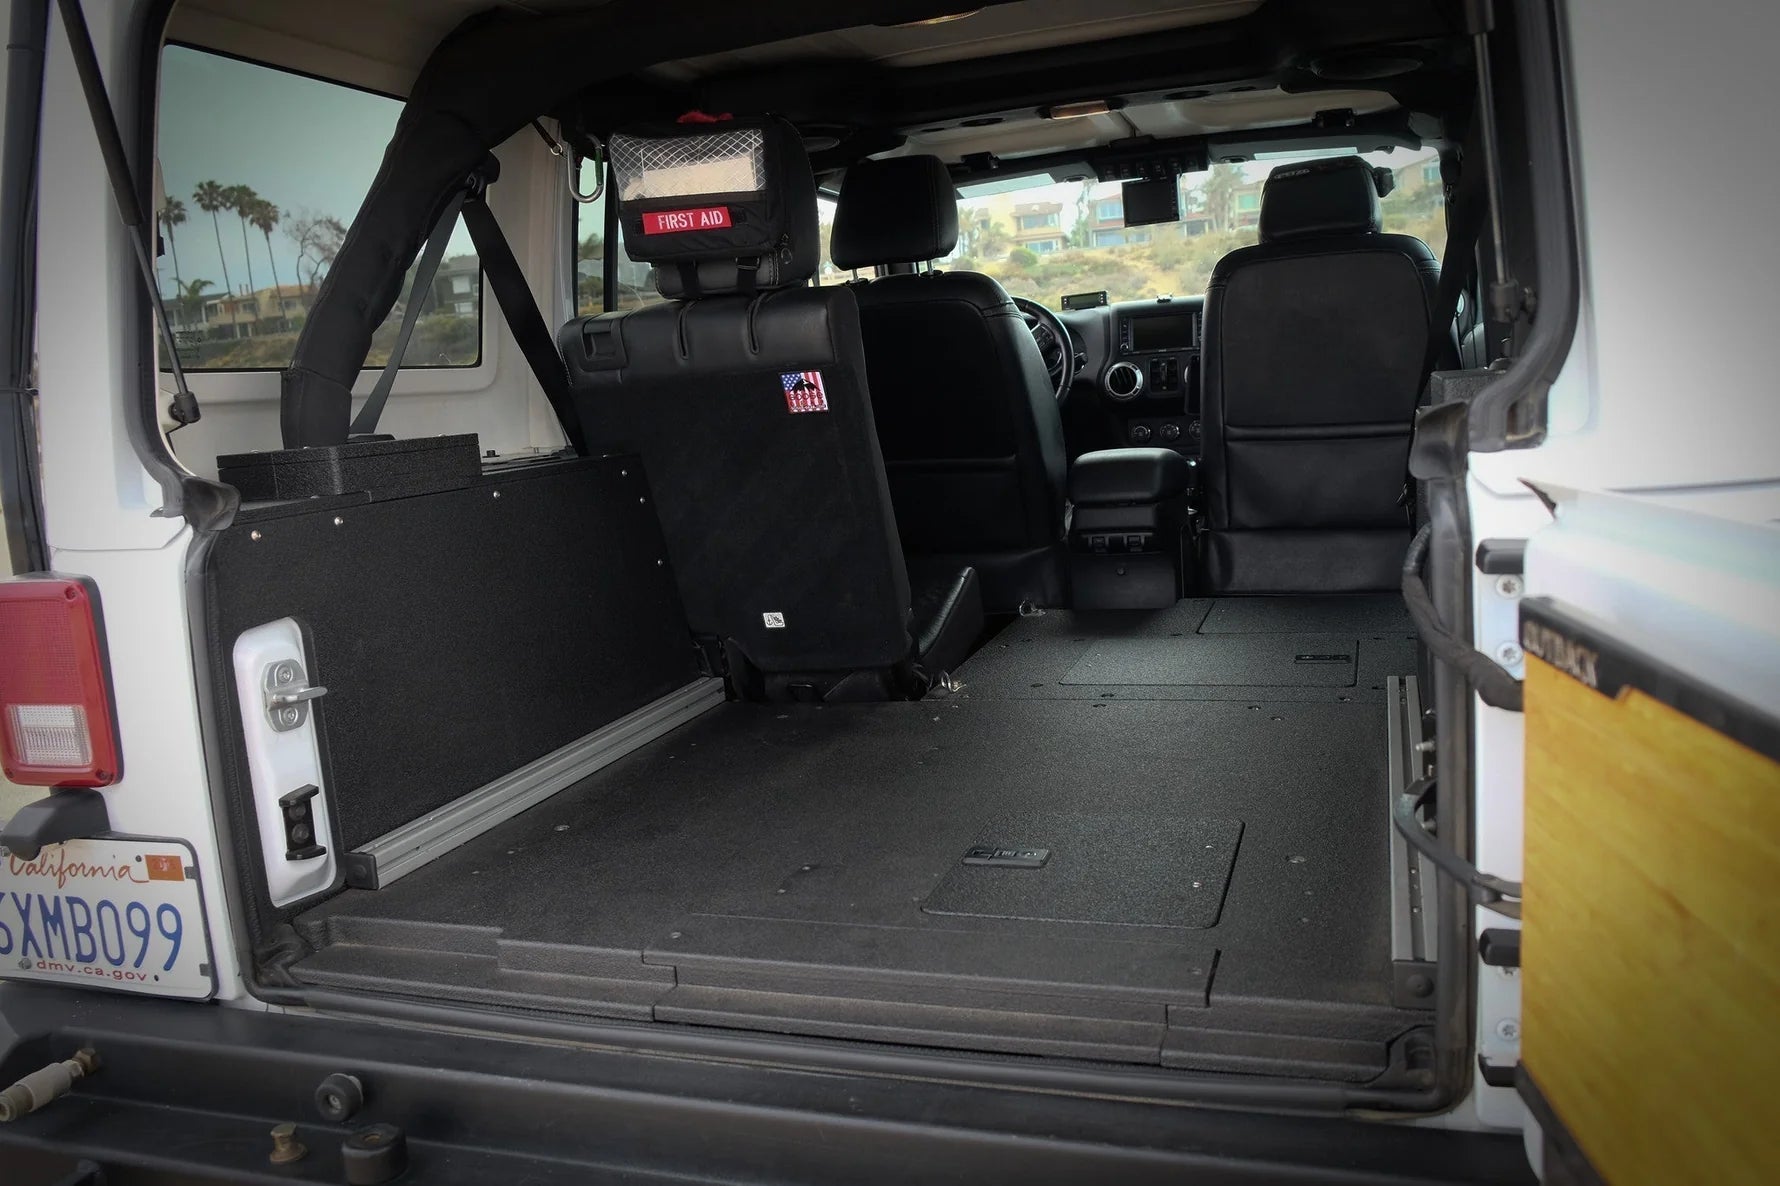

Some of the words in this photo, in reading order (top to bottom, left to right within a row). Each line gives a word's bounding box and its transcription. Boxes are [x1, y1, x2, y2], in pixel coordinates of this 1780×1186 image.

[657, 213, 694, 230] FIRST
[701, 210, 723, 225] AID
[9, 849, 149, 889] California
[36, 961, 147, 981] dmv.ca.gov
